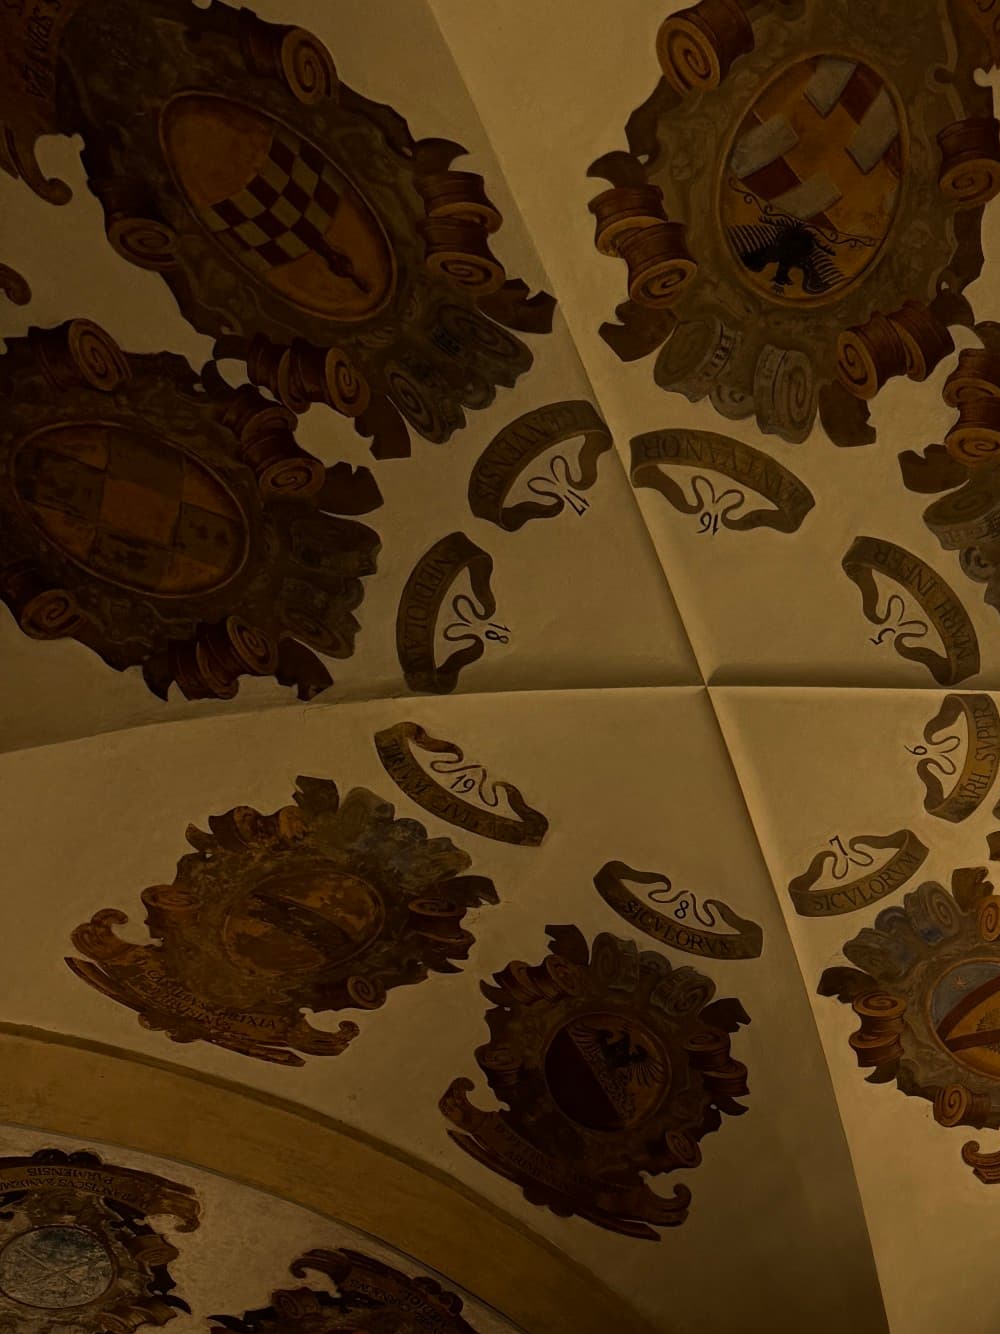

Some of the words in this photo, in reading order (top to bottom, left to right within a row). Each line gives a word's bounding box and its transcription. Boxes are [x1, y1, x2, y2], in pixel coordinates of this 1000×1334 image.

[564, 488, 591, 518] 17
[696, 511, 720, 536] 16
[484, 622, 512, 646] 18
[871, 627, 897, 646] 5
[903, 743, 928, 757] 6
[451, 774, 475, 794] 19
[808, 850, 921, 913] SICVLORVM
[673, 899, 689, 919] 8
